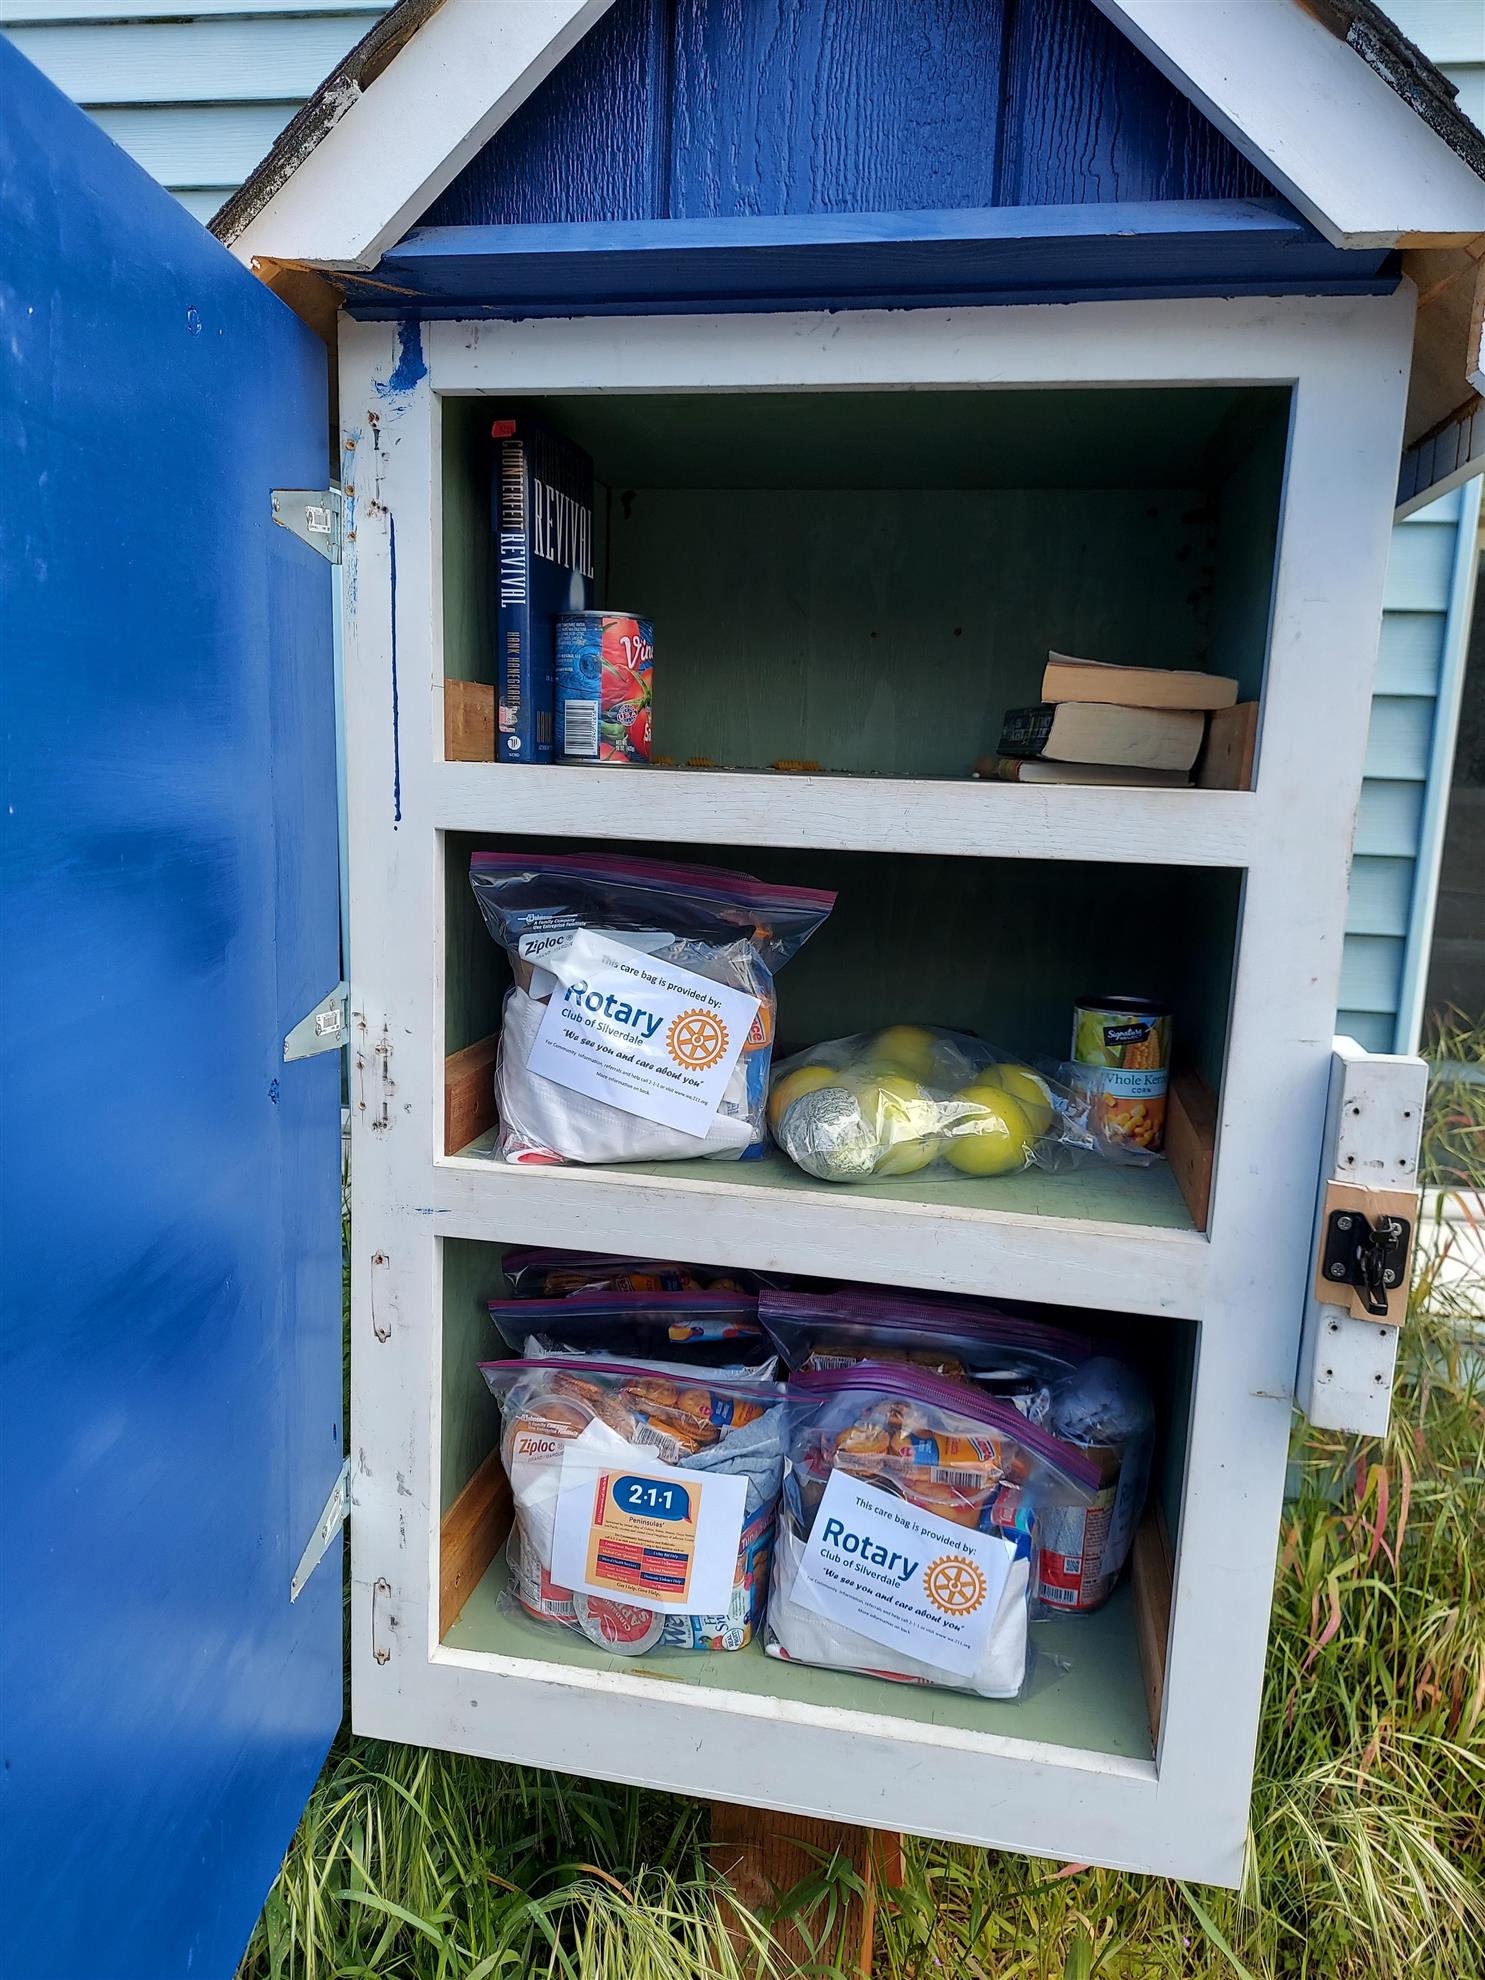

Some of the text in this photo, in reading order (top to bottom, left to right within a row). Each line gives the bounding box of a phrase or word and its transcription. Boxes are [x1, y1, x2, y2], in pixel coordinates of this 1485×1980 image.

[500, 440, 526, 608] COUNTERFEIT REVIVAL
[534, 478, 594, 579] REVIVAL
[507, 632, 521, 653] HANK
[525, 936, 564, 957] Ziploc
[601, 954, 722, 1009] This care bag is provided by:
[561, 1007, 644, 1046] Club of Silverdale
[564, 979, 664, 1038] Rotary
[1107, 1028, 1143, 1041] Signature
[580, 1037, 596, 1048] see
[596, 1042, 614, 1056] you
[615, 1051, 634, 1063] and
[635, 1058, 655, 1070] care
[655, 1063, 682, 1081] about
[622, 1068, 632, 1076] and
[631, 1071, 641, 1082] help
[640, 1075, 649, 1083] call
[519, 1438, 556, 1456] Ziploc
[856, 1496, 977, 1556] This care bag is provided by:
[820, 1548, 901, 1588] Club of Silverdale
[822, 1517, 920, 1582] Rotary
[840, 1576, 855, 1587] see
[856, 1583, 874, 1596] you
[875, 1591, 894, 1603] and
[894, 1599, 914, 1611] care
[914, 1607, 942, 1624] about
